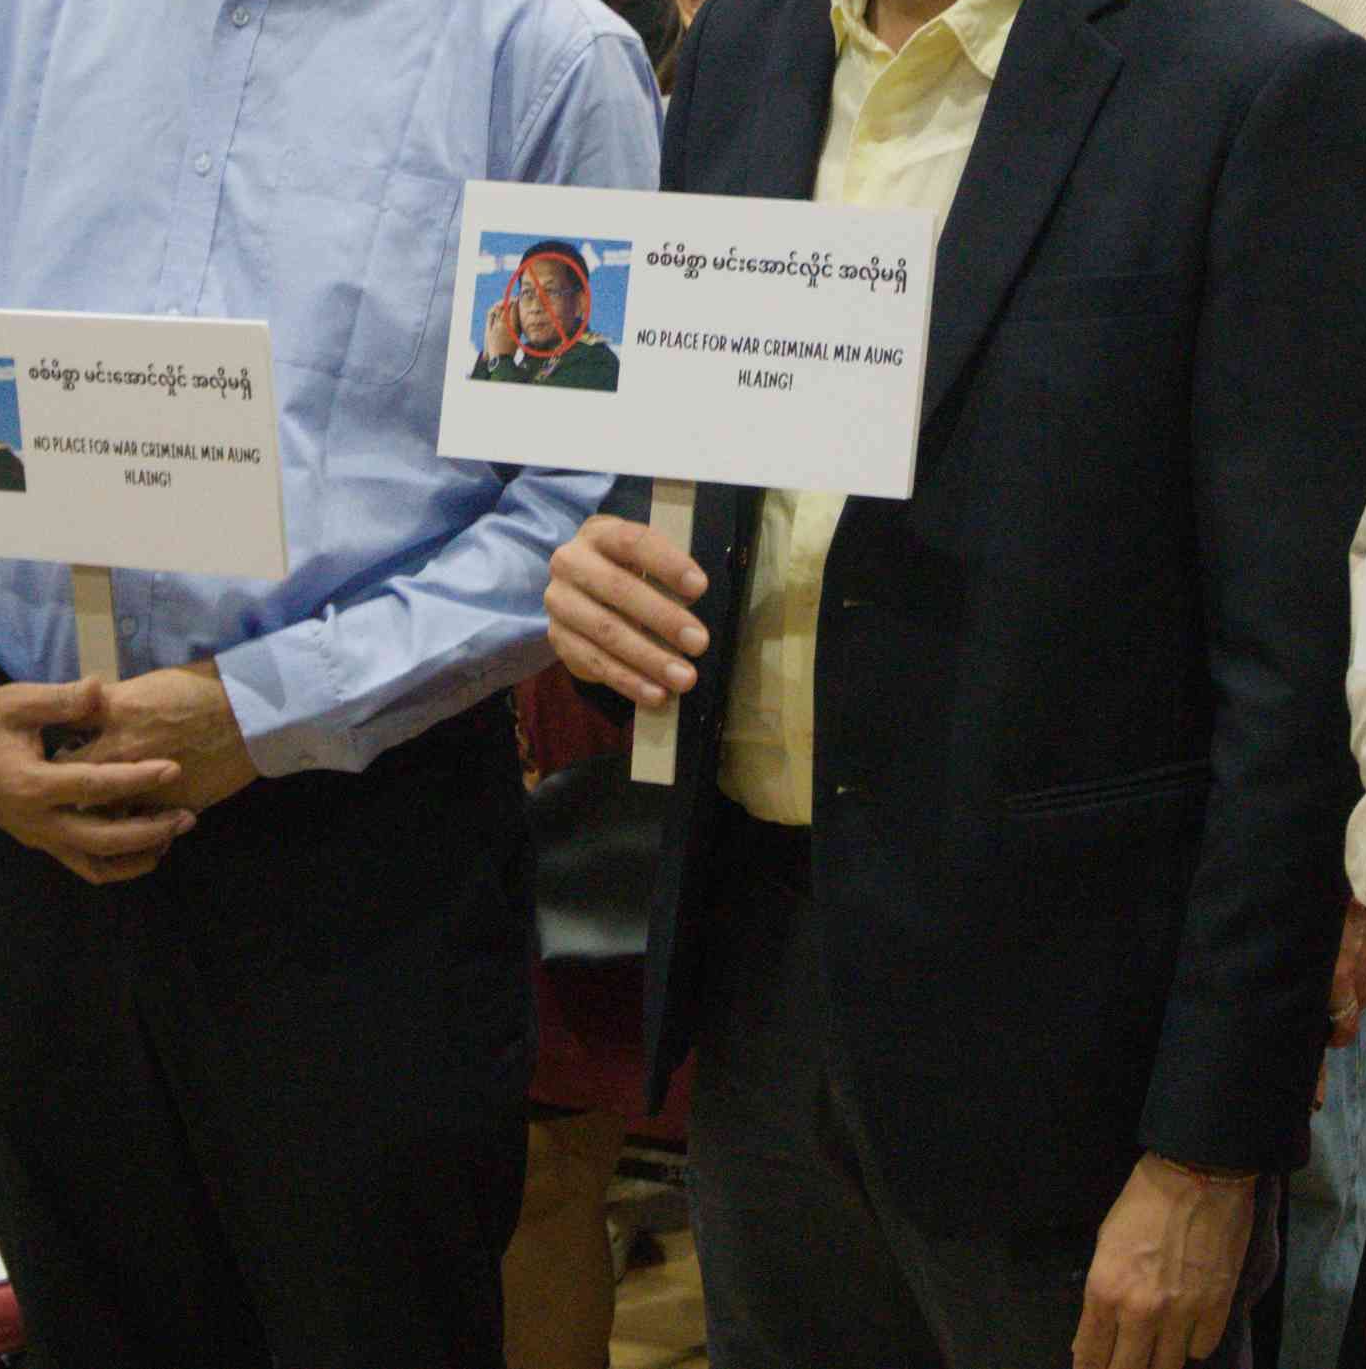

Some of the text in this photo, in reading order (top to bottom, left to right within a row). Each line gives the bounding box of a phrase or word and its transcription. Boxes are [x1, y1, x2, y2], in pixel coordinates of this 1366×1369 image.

[839, 257, 907, 293] အလိုမရှိ
[637, 329, 903, 366] NO PLACE FOR WAR CRIMINAL MIN AUNG
[738, 369, 794, 390] HLAING!
[34, 436, 261, 464] NO PLACE FOR WAR CRIMINAL MIN AUNG
[125, 470, 171, 487] HLAING!
